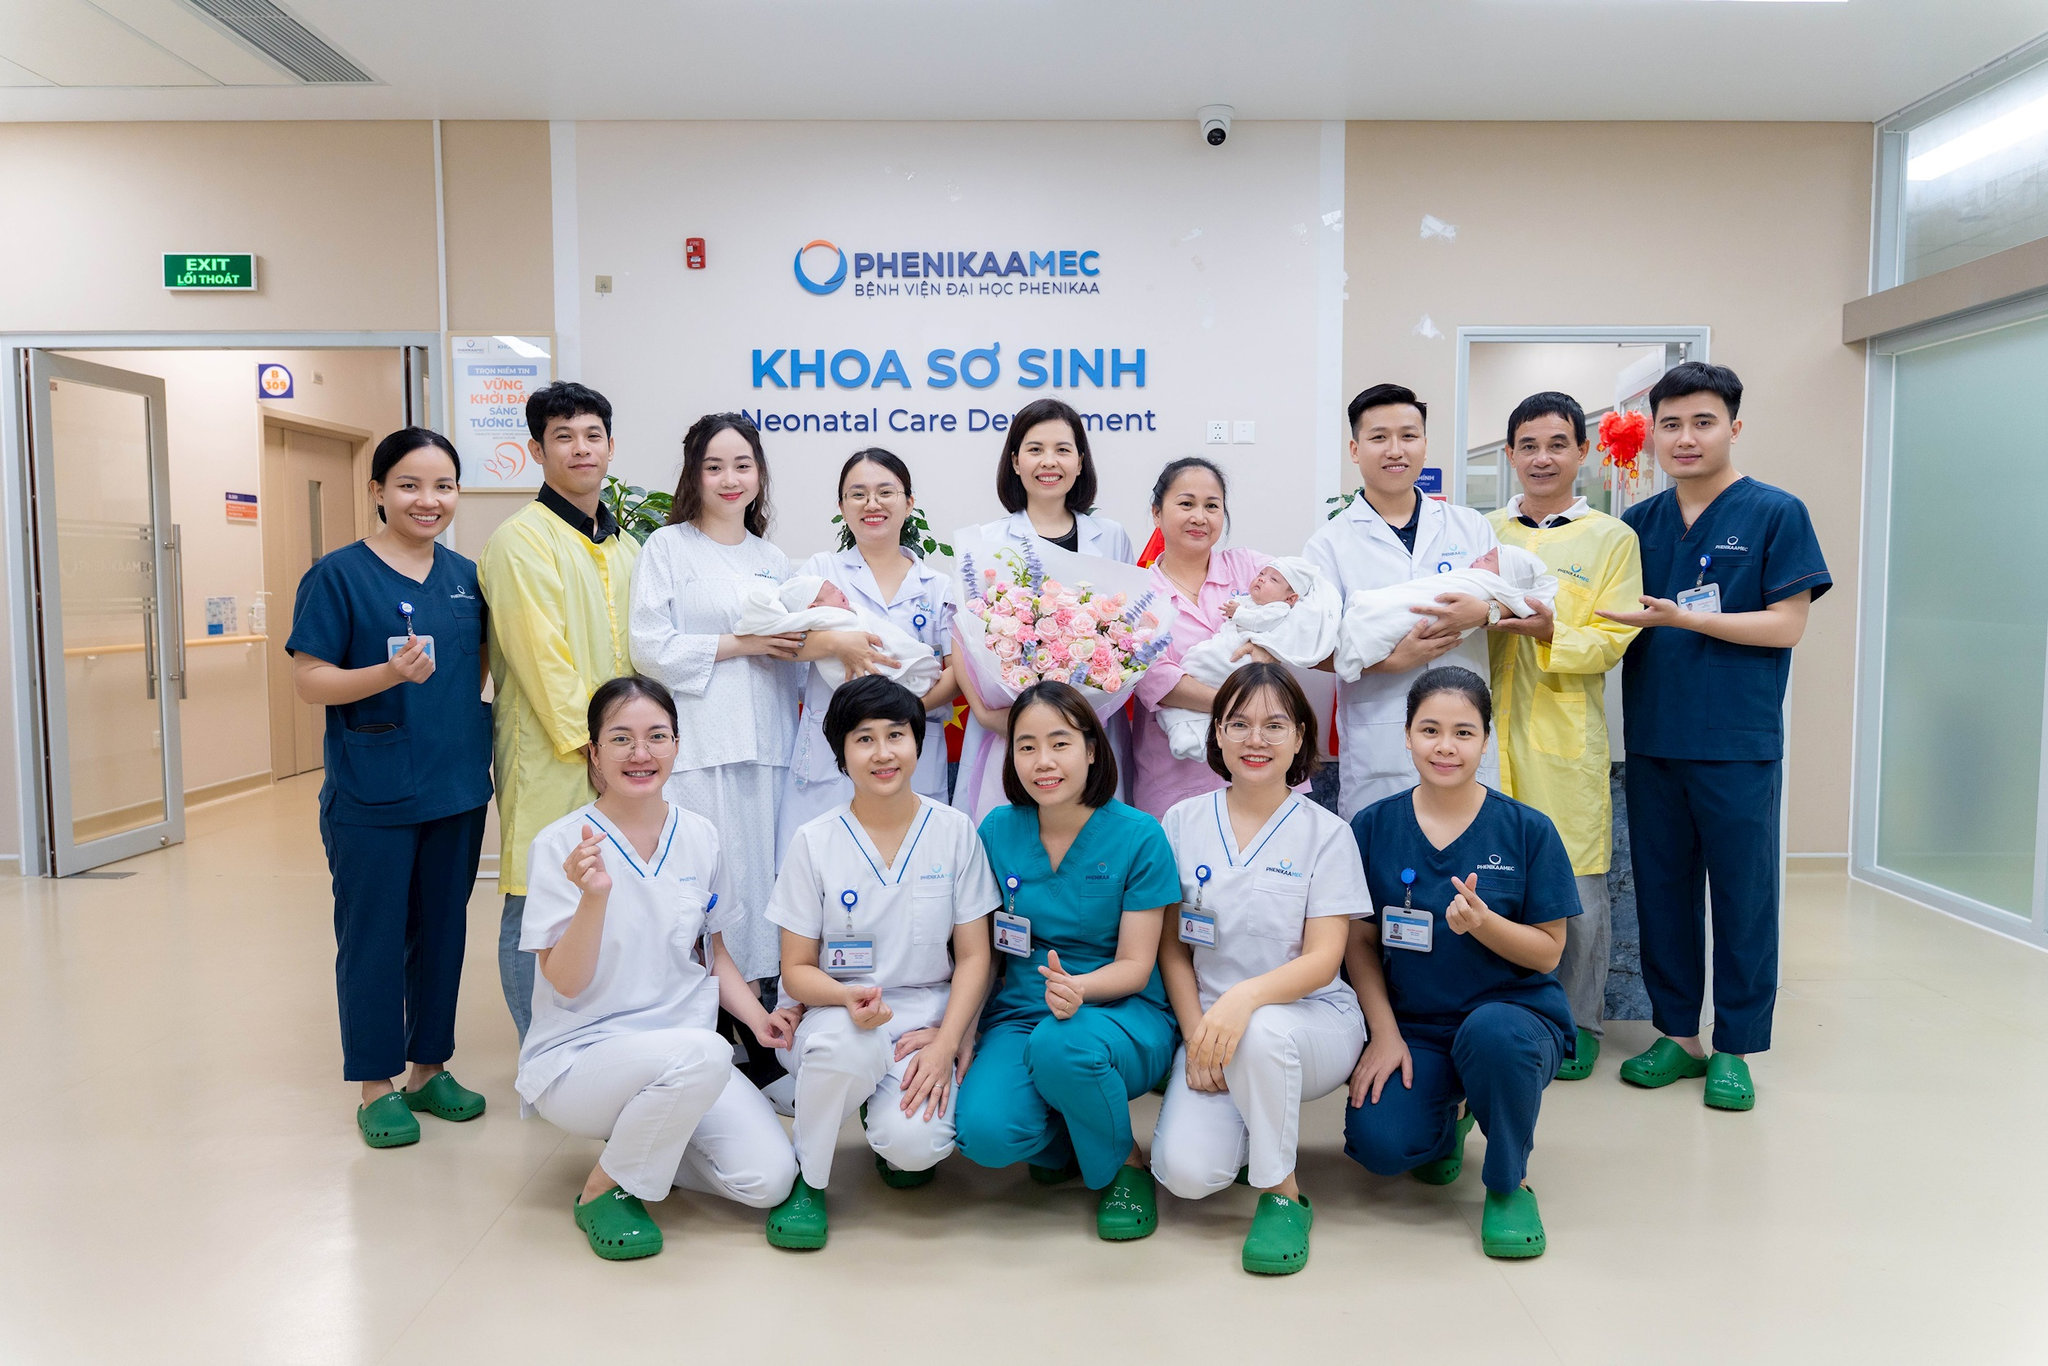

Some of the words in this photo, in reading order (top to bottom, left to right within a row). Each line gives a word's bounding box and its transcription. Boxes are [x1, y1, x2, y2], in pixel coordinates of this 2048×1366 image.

[186, 258, 230, 271] EXIT
[854, 250, 1100, 278] PHENIKAAMEC
[177, 271, 197, 284] LỐI
[198, 272, 240, 284] THOÁT
[855, 281, 899, 299] BỆNH
[904, 280, 941, 299] VIỆN
[946, 282, 973, 298] ĐẠI
[979, 282, 1013, 298] HỌC
[1019, 281, 1100, 295] PHENIKAA
[752, 348, 912, 389] KHOA
[926, 341, 1001, 389] SƠ
[1017, 348, 1146, 388] SINH
[271, 370, 279, 379] B
[475, 368, 496, 376] TRỌN
[265, 381, 287, 390] 309
[483, 377, 523, 390] VỮNG
[507, 390, 530, 405] ĐẦ
[489, 405, 518, 415] SÁNG
[470, 417, 513, 428] TƯƠNG
[741, 407, 878, 433] Neonatal
[888, 408, 958, 433] Care
[968, 408, 1157, 433] Dement
[1265, 866, 1304, 878] PHENIKAAMEC
[1476, 864, 1515, 872] PHENIKAAMEC
